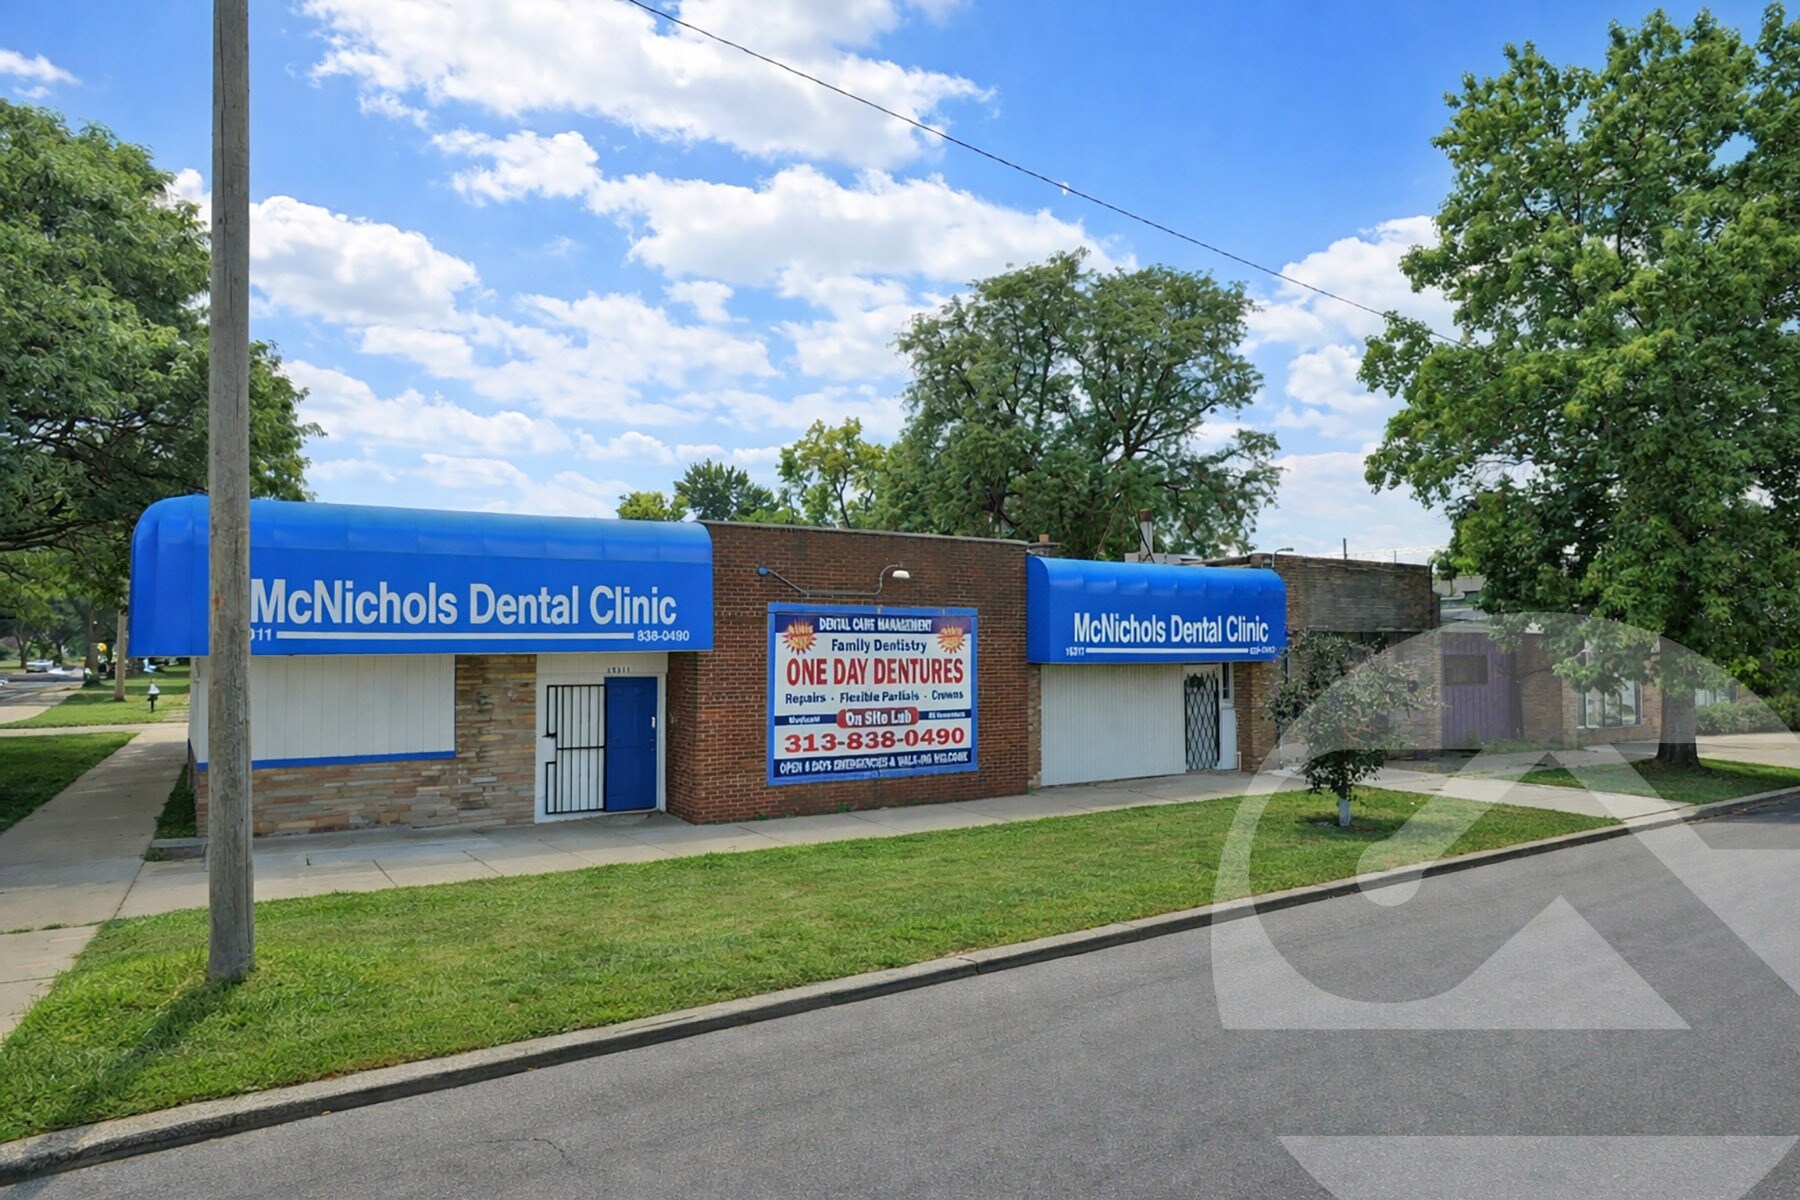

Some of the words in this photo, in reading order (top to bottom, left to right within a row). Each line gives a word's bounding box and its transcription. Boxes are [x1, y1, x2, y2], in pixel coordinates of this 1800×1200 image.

[251, 578, 458, 625] McNichols
[470, 582, 579, 625] Dental
[590, 584, 677, 625] Clinic
[1073, 612, 1166, 643] McNichols
[1170, 614, 1222, 643] Dental
[1226, 615, 1269, 643] Clinic
[831, 638, 870, 654] Family
[874, 639, 927, 655] Dentistry
[786, 657, 828, 686] ONE
[833, 657, 869, 685] DAY
[873, 657, 964, 685] DENTURES
[785, 691, 826, 706] Repairs
[839, 690, 880, 704] Flexible
[882, 689, 920, 702] Partials
[931, 689, 964, 701] Crowns
[845, 712, 863, 726] On
[864, 711, 889, 725] Site
[890, 710, 912, 724] Lab
[784, 727, 965, 754] 313-838-0490
[779, 761, 802, 775] OPEN
